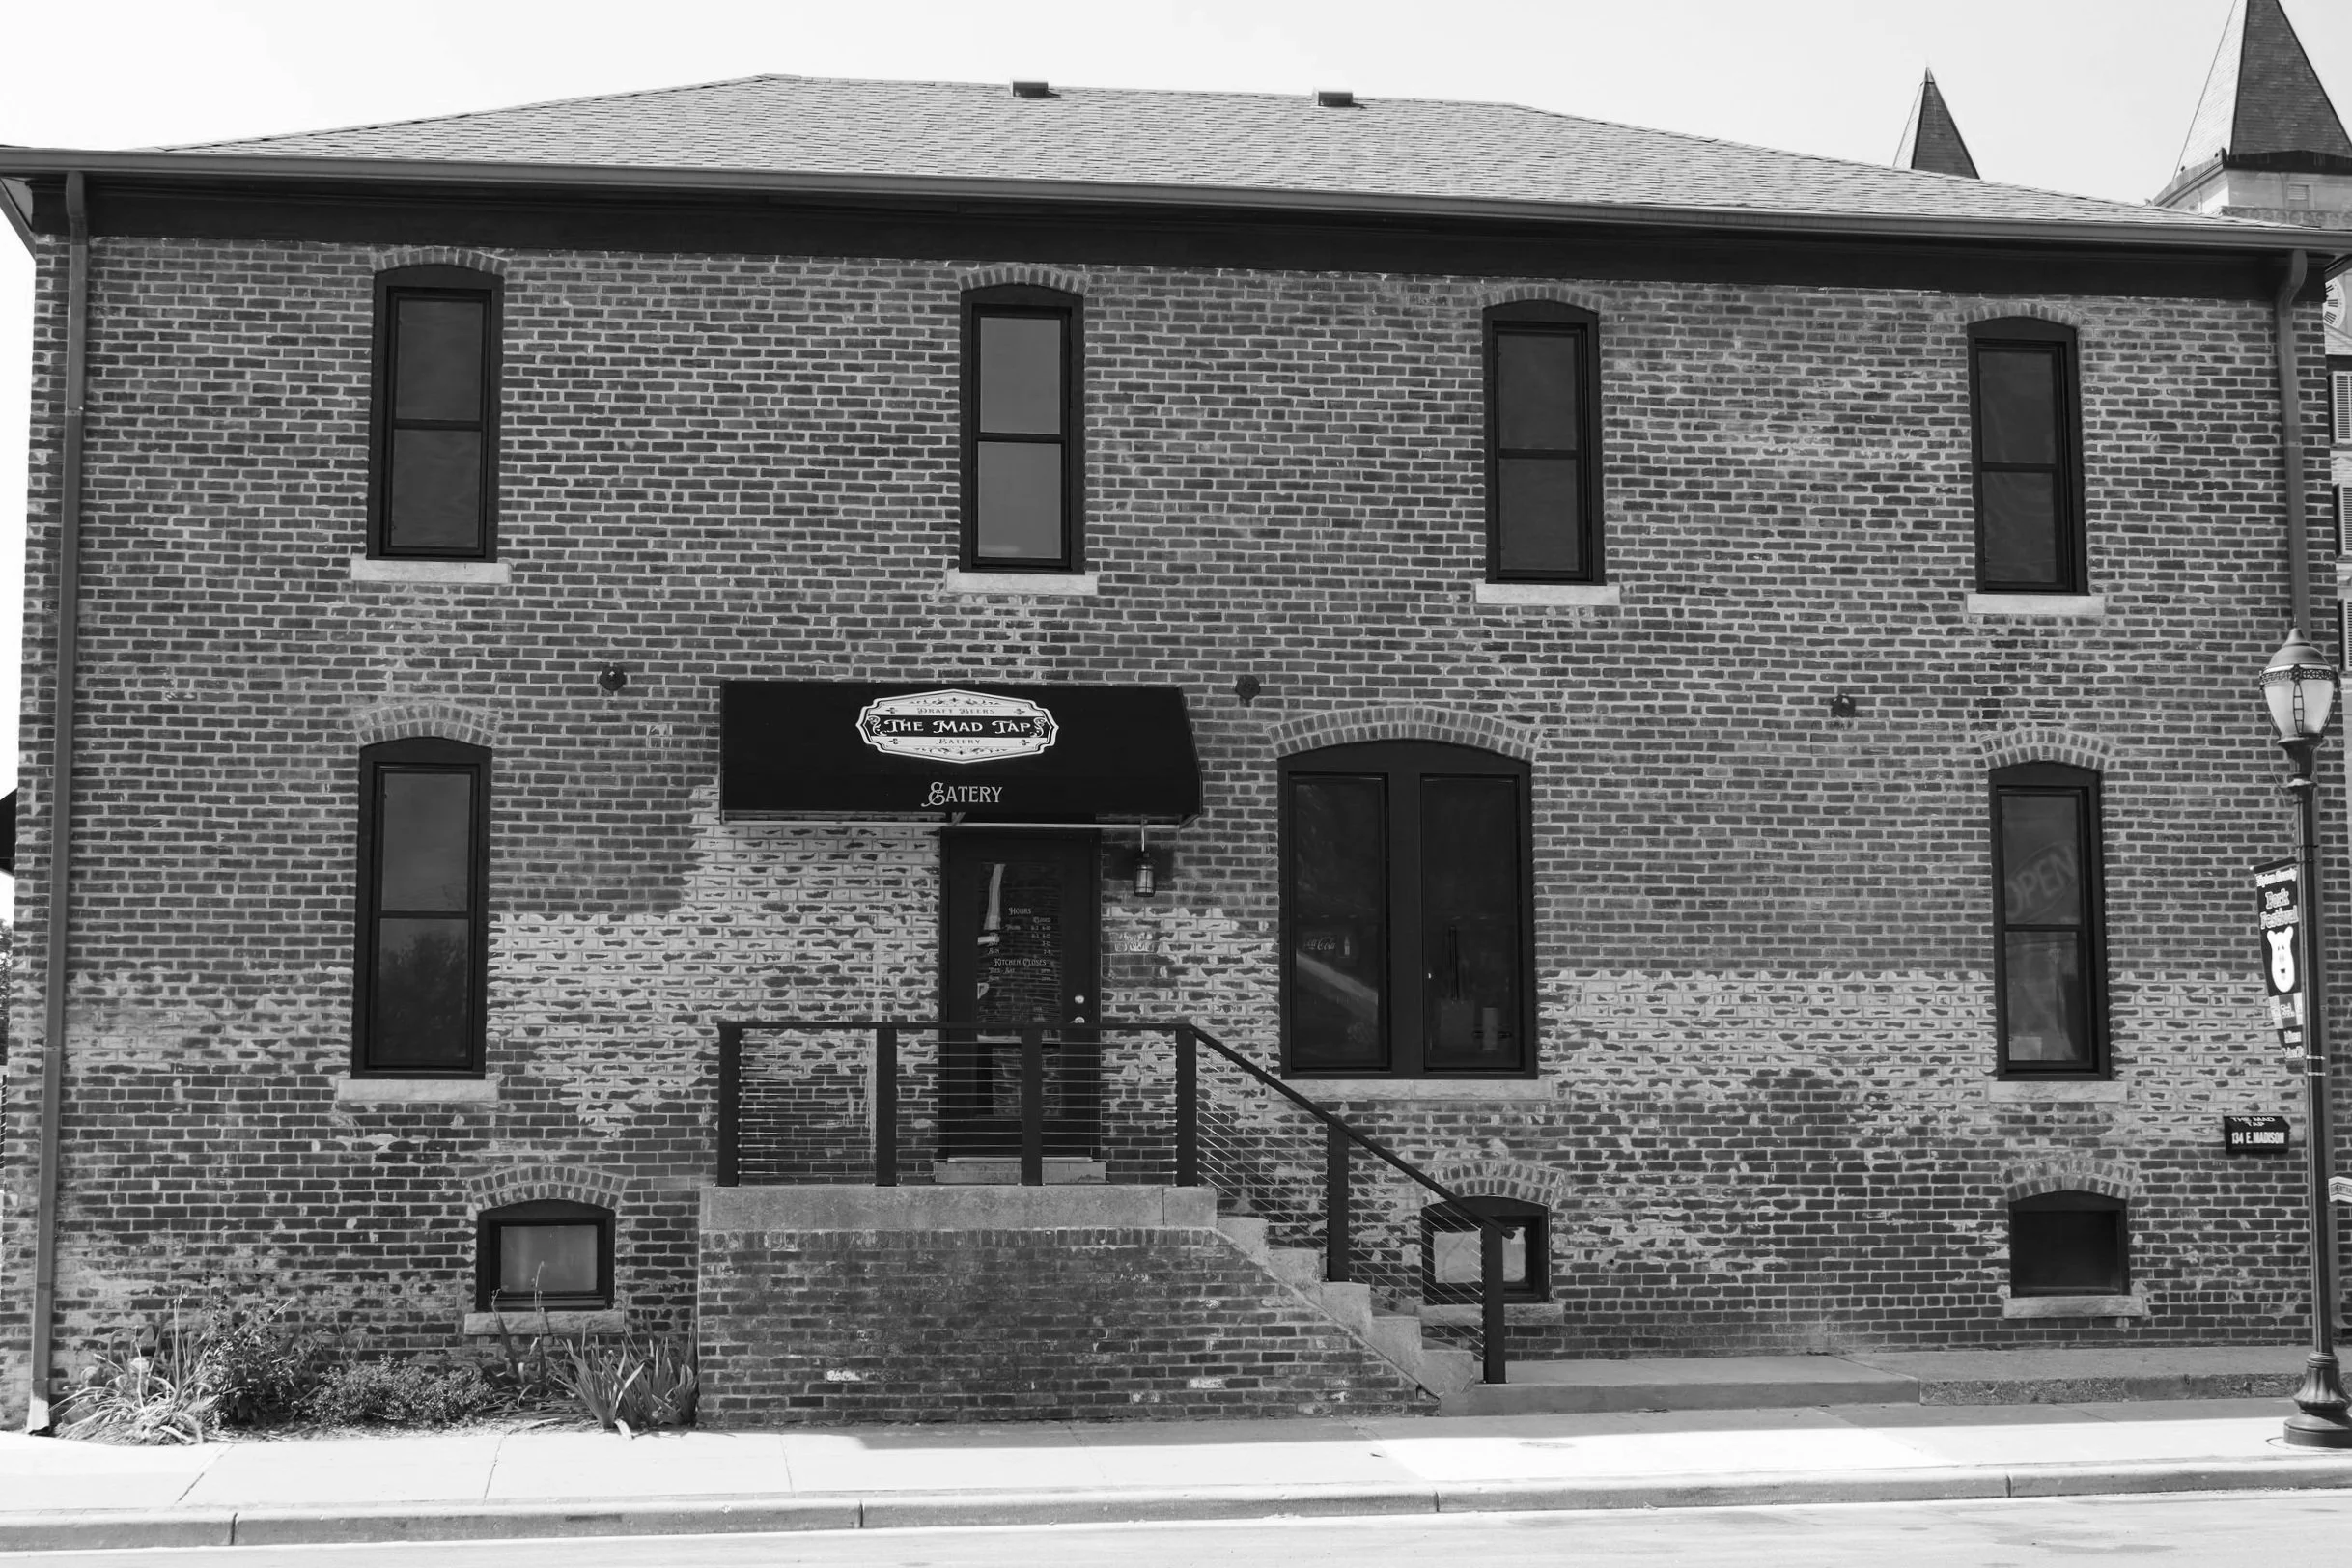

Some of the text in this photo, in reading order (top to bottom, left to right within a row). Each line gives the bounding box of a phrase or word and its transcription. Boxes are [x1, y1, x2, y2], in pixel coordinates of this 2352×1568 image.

[883, 718, 1031, 734] THE MAD TAP
[920, 781, 1003, 808] EATERY
[2005, 845, 2077, 919] OPEN
[2265, 888, 2290, 910] Pork
[1008, 907, 1032, 916] HOURS
[2260, 905, 2299, 930] Festival
[993, 958, 1047, 967] KITCHEN CLOSES
[2231, 1131, 2244, 1145] 134
